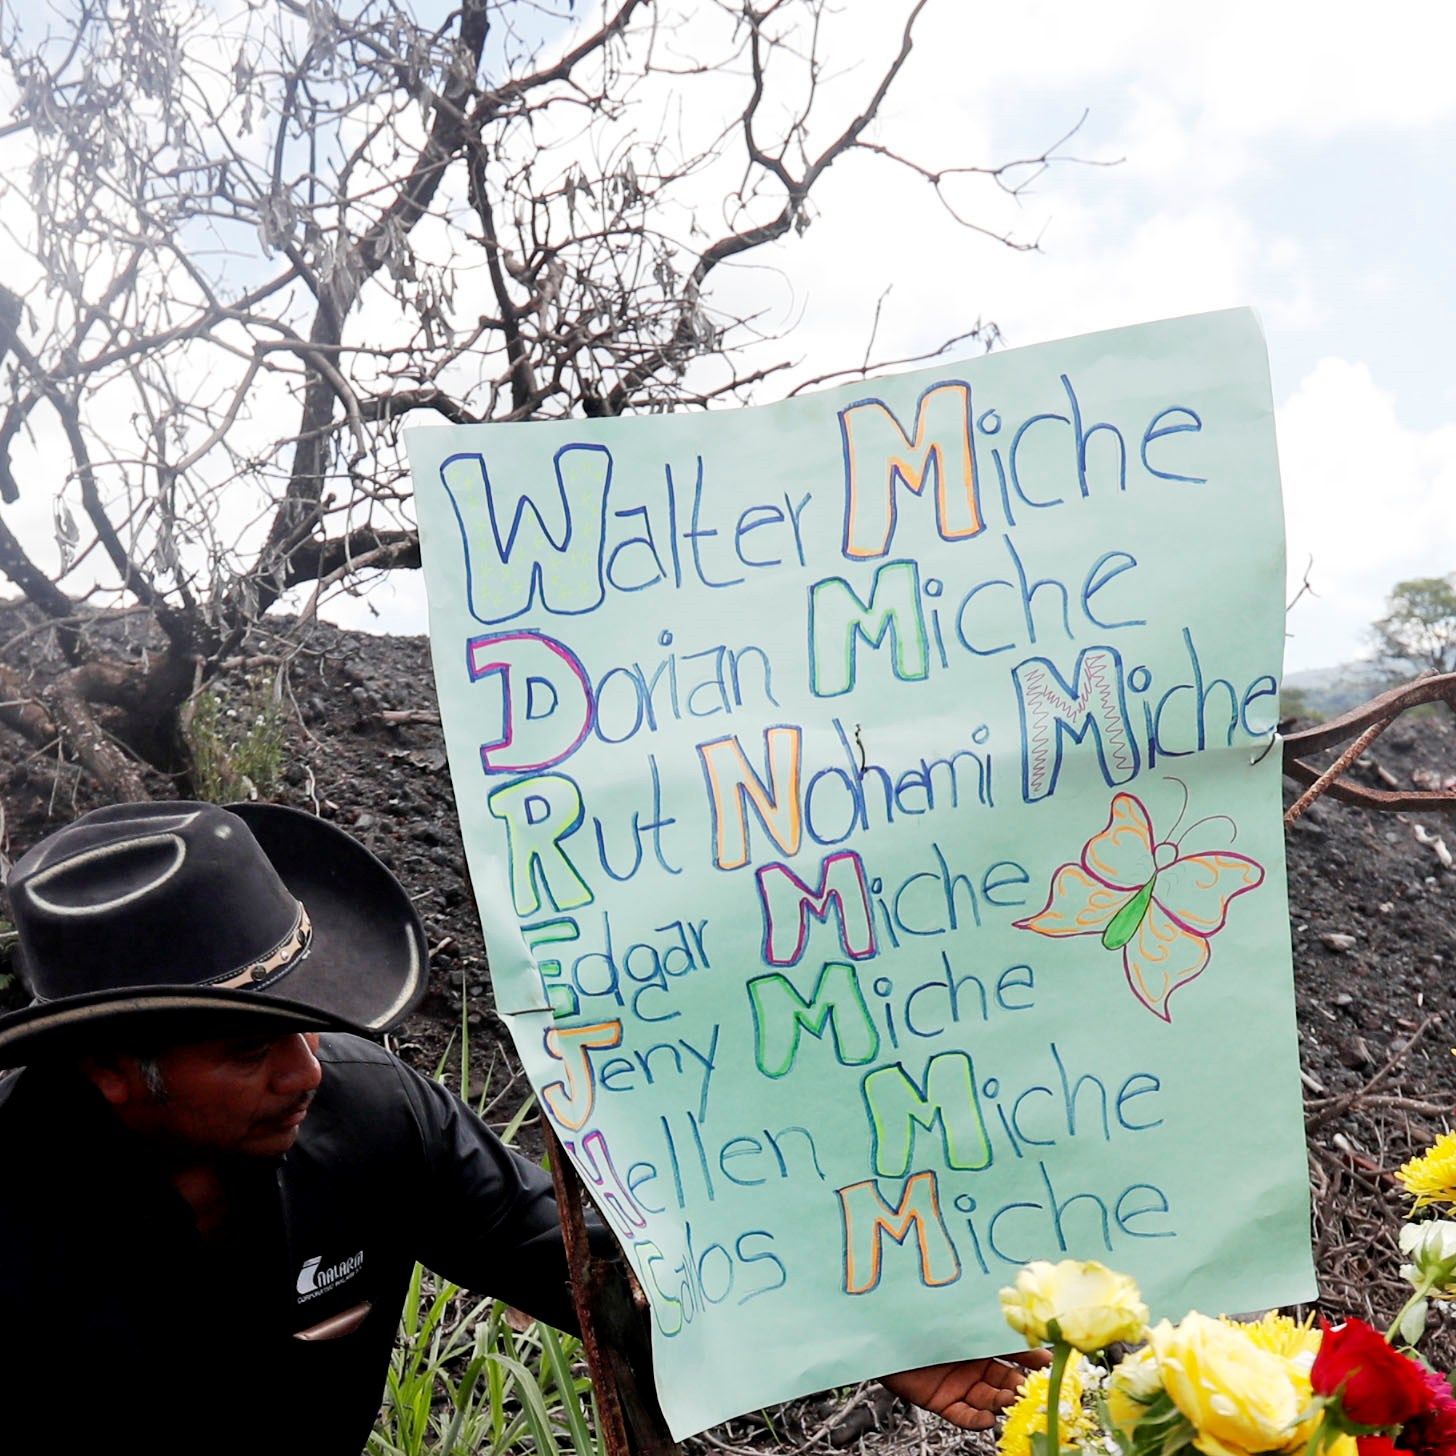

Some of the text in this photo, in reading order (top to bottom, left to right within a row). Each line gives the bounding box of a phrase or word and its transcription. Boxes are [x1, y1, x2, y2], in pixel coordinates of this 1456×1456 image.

[440, 372, 1207, 624] Walter Miche
[465, 534, 1146, 775] Dorian Miche
[488, 627, 1279, 918] Rut Nohemi Miche
[519, 842, 1031, 1022] Edgar Miche
[540, 950, 1035, 1133] Jeny Miche
[564, 1042, 1165, 1240] Hellen Miche
[835, 1161, 1177, 1296] Miche
